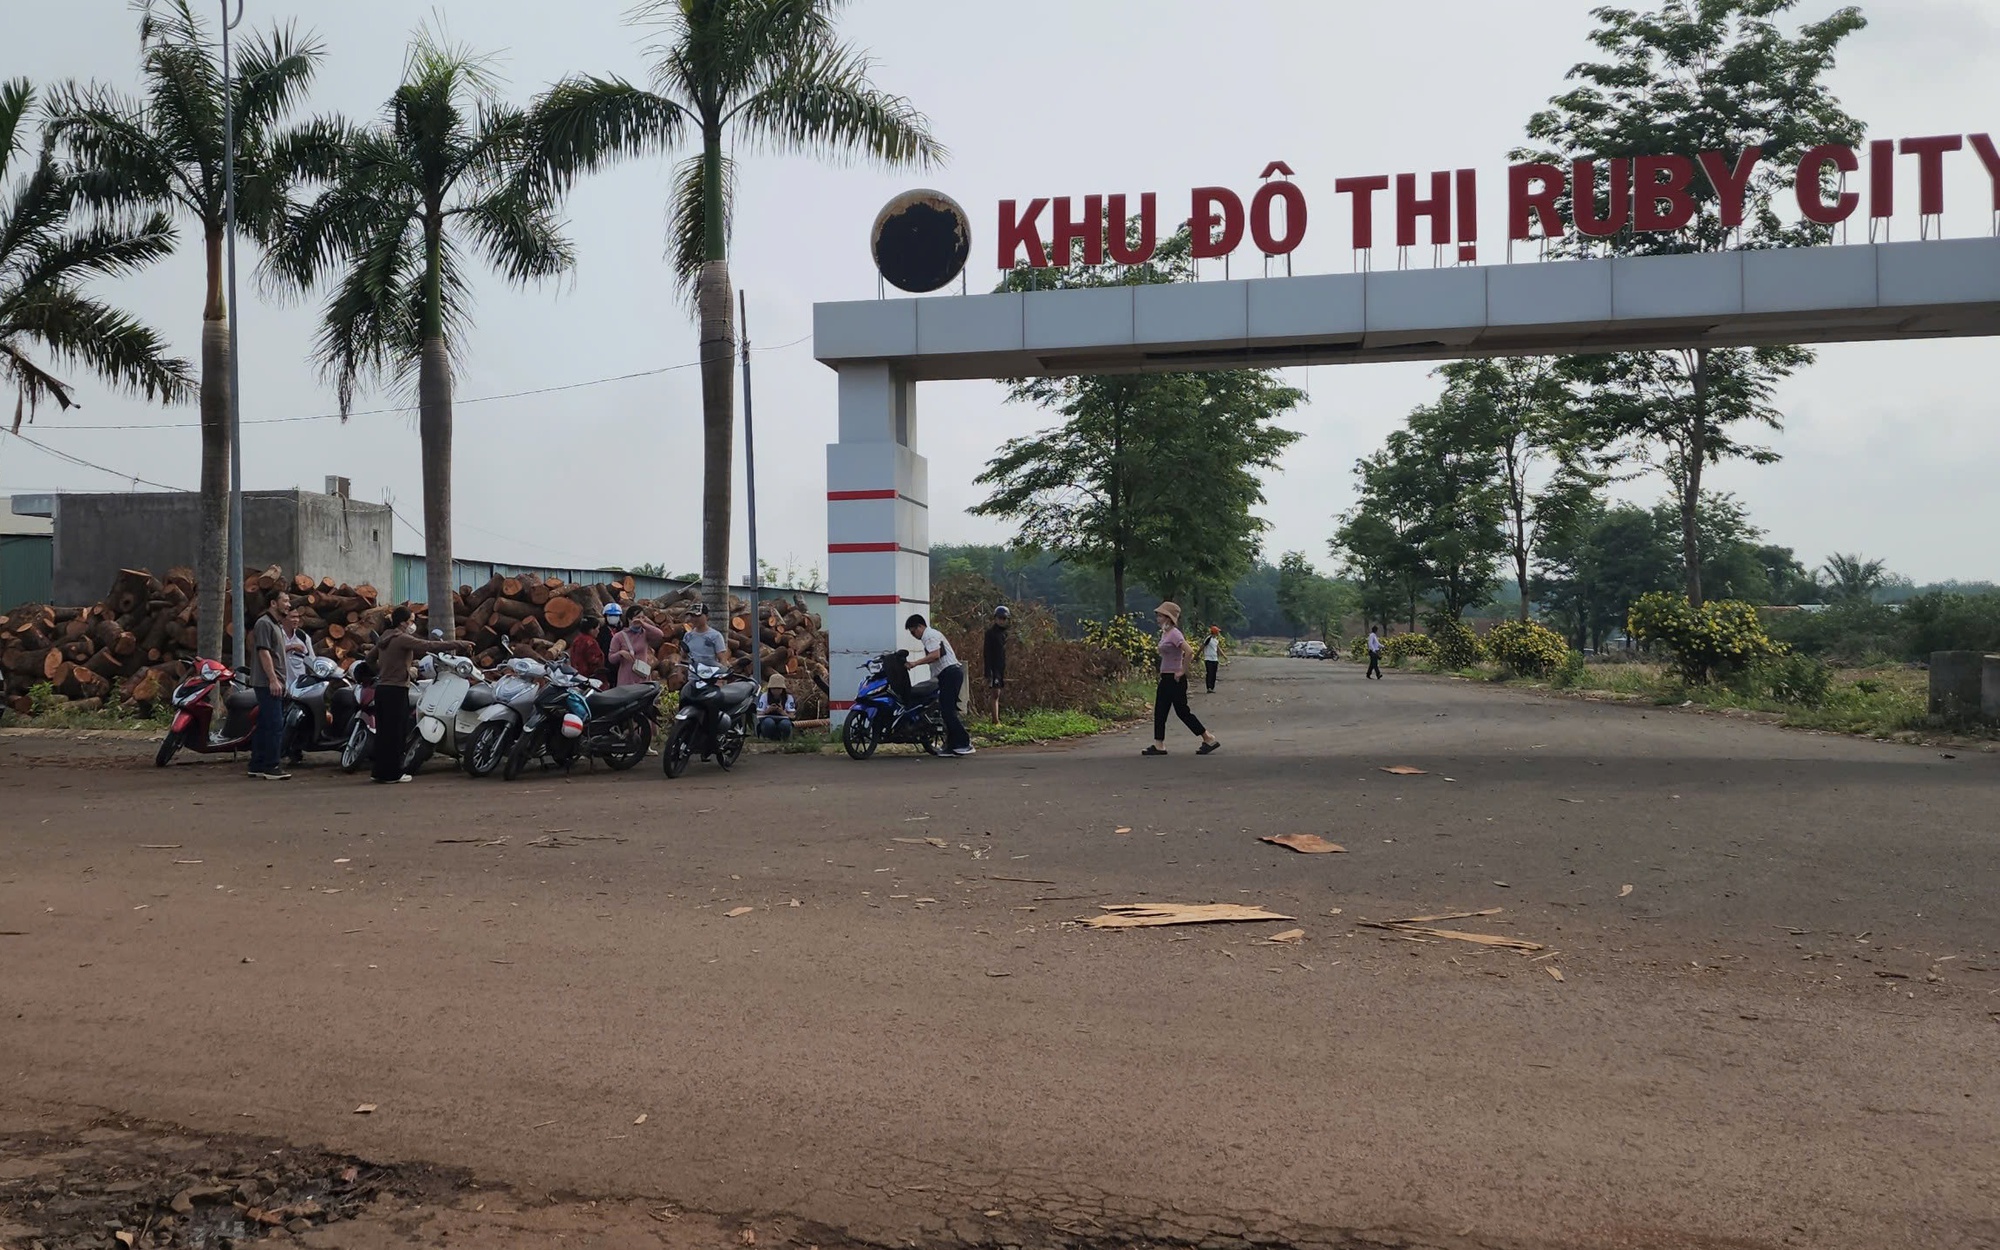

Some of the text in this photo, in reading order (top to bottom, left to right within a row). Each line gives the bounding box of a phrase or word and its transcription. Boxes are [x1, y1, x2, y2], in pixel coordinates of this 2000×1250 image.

[998, 192, 1156, 270] KHU
[1187, 160, 1308, 260] ĐÔ
[1335, 168, 1477, 262] THỊ
[1508, 146, 1762, 240] RUBY
